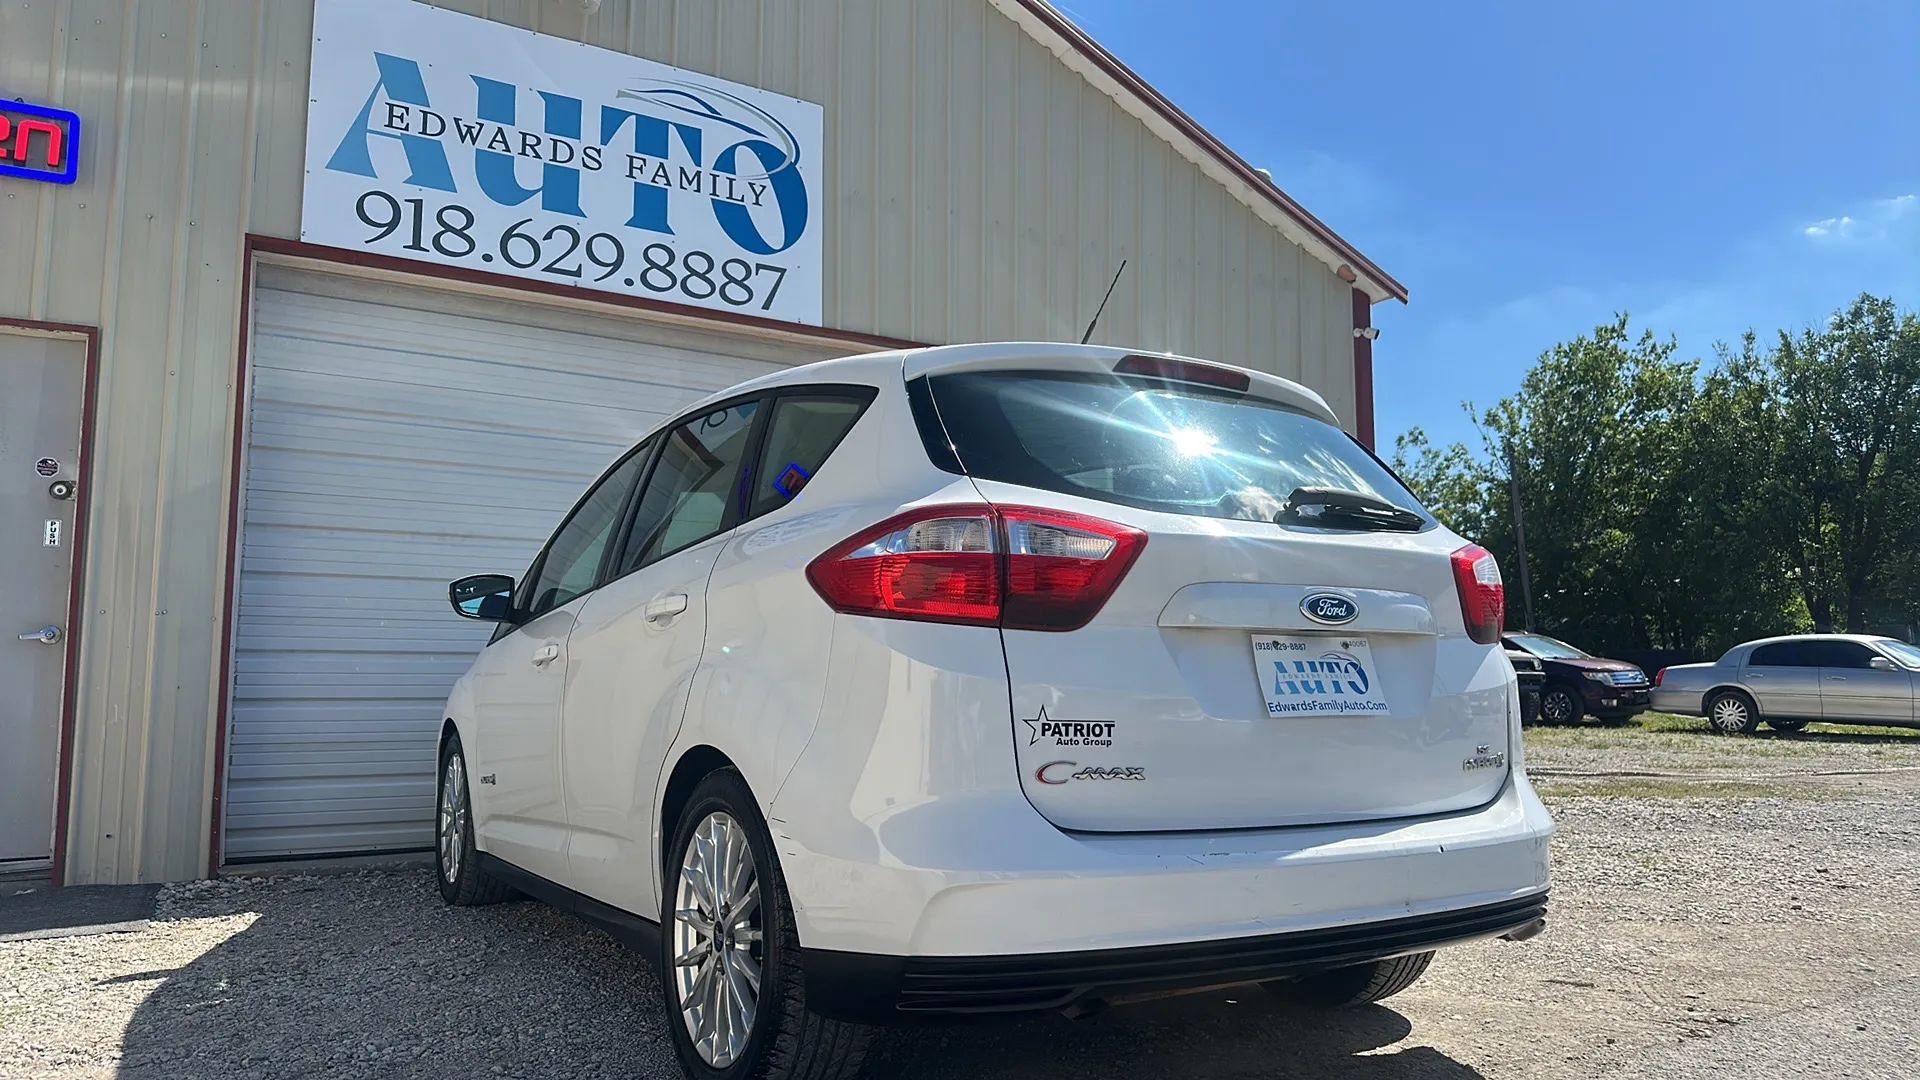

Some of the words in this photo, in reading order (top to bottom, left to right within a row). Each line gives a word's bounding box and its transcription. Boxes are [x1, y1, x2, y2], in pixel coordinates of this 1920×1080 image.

[384, 102, 603, 171] EDWARDS
[625, 154, 768, 207] FAMILY
[355, 191, 787, 310] 918.629.8887
[49, 521, 57, 545] PUSH
[1317, 599, 1348, 617] Ford
[1255, 640, 1306, 651] (918)29-8887
[1268, 700, 1388, 713] EdwardsFamilyAuto.Com
[1041, 723, 1116, 738] PATRIOT
[1056, 738, 1080, 746] Auto
[1083, 738, 1113, 748] Group
